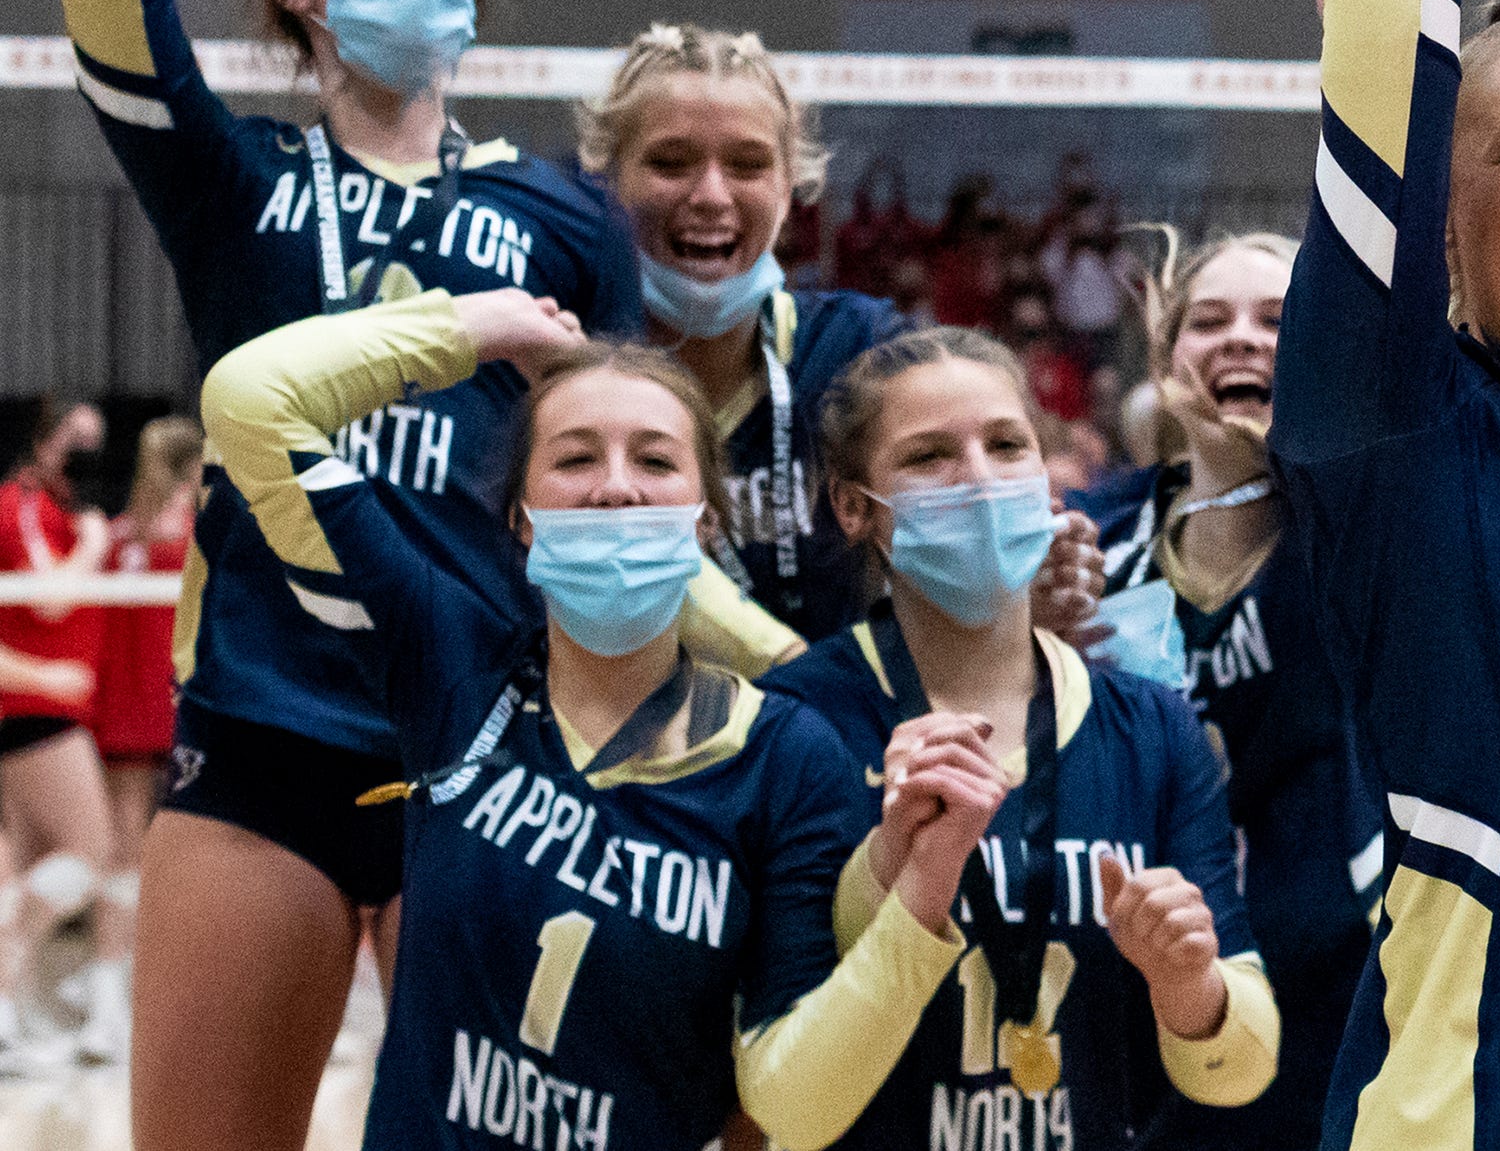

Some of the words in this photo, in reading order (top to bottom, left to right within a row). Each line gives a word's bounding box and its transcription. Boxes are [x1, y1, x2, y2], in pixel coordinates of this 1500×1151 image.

[463, 766, 732, 949] APPLETON
[519, 909, 597, 1056] 1
[445, 1029, 615, 1151] NORTH
